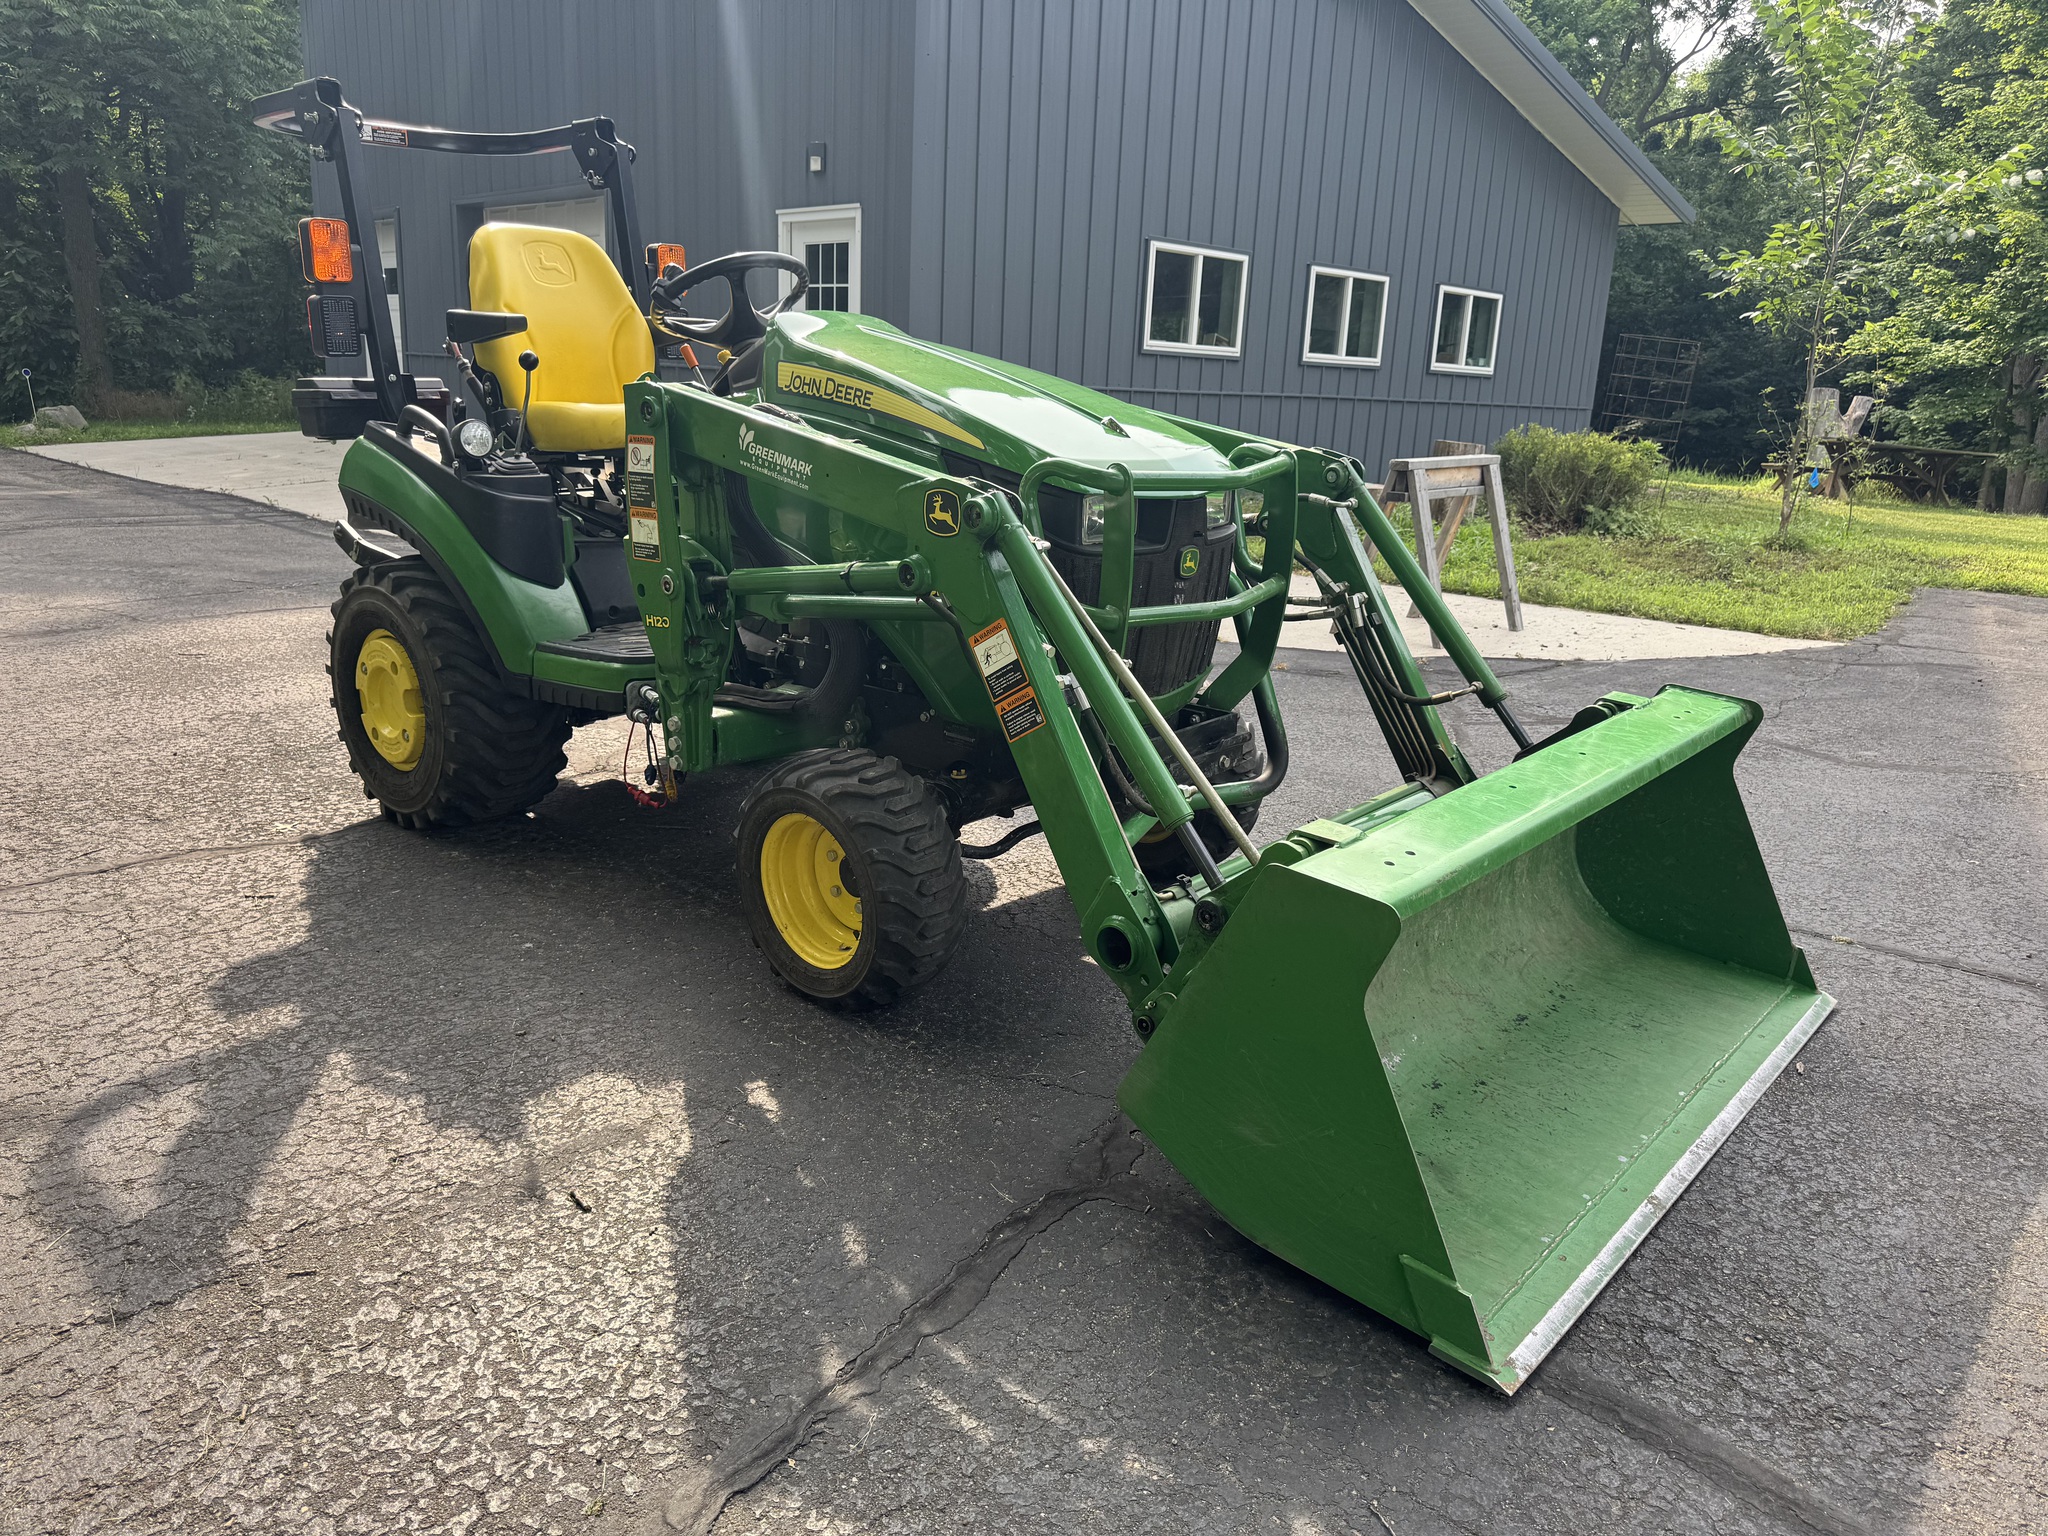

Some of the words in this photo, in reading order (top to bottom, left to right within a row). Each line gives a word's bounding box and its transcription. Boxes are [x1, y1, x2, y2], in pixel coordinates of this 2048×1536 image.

[785, 371, 822, 394] JOHN
[824, 377, 874, 407] DEERE
[632, 436, 654, 445] WARNING
[748, 442, 813, 476] GREENMARK
[752, 456, 807, 481] EQUIPMENT
[979, 622, 1003, 641] WARNING
[1006, 691, 1031, 708] WARNING
